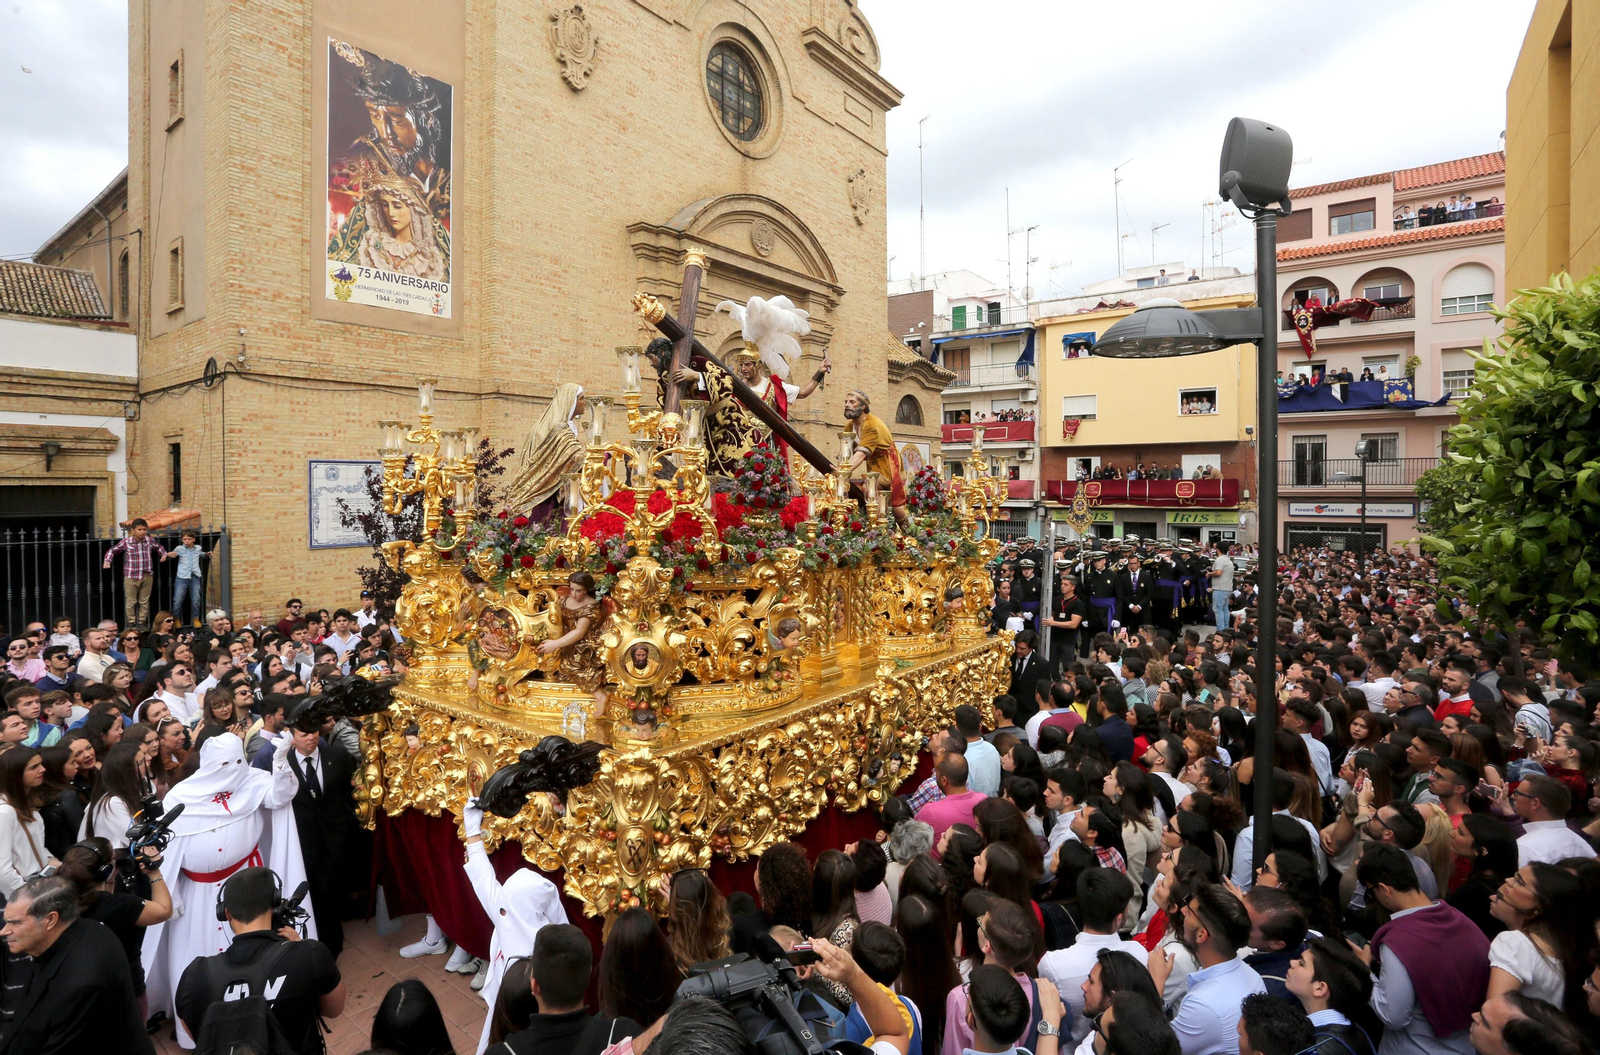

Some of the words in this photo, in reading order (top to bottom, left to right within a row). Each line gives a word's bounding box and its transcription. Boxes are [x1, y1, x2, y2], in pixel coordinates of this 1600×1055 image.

[358, 267, 371, 279] 75
[373, 270, 449, 294] ANIVERSARIO
[355, 284, 386, 294] HERMANDAD
[375, 294, 390, 302] 1944
[1173, 512, 1209, 522] IRIS
